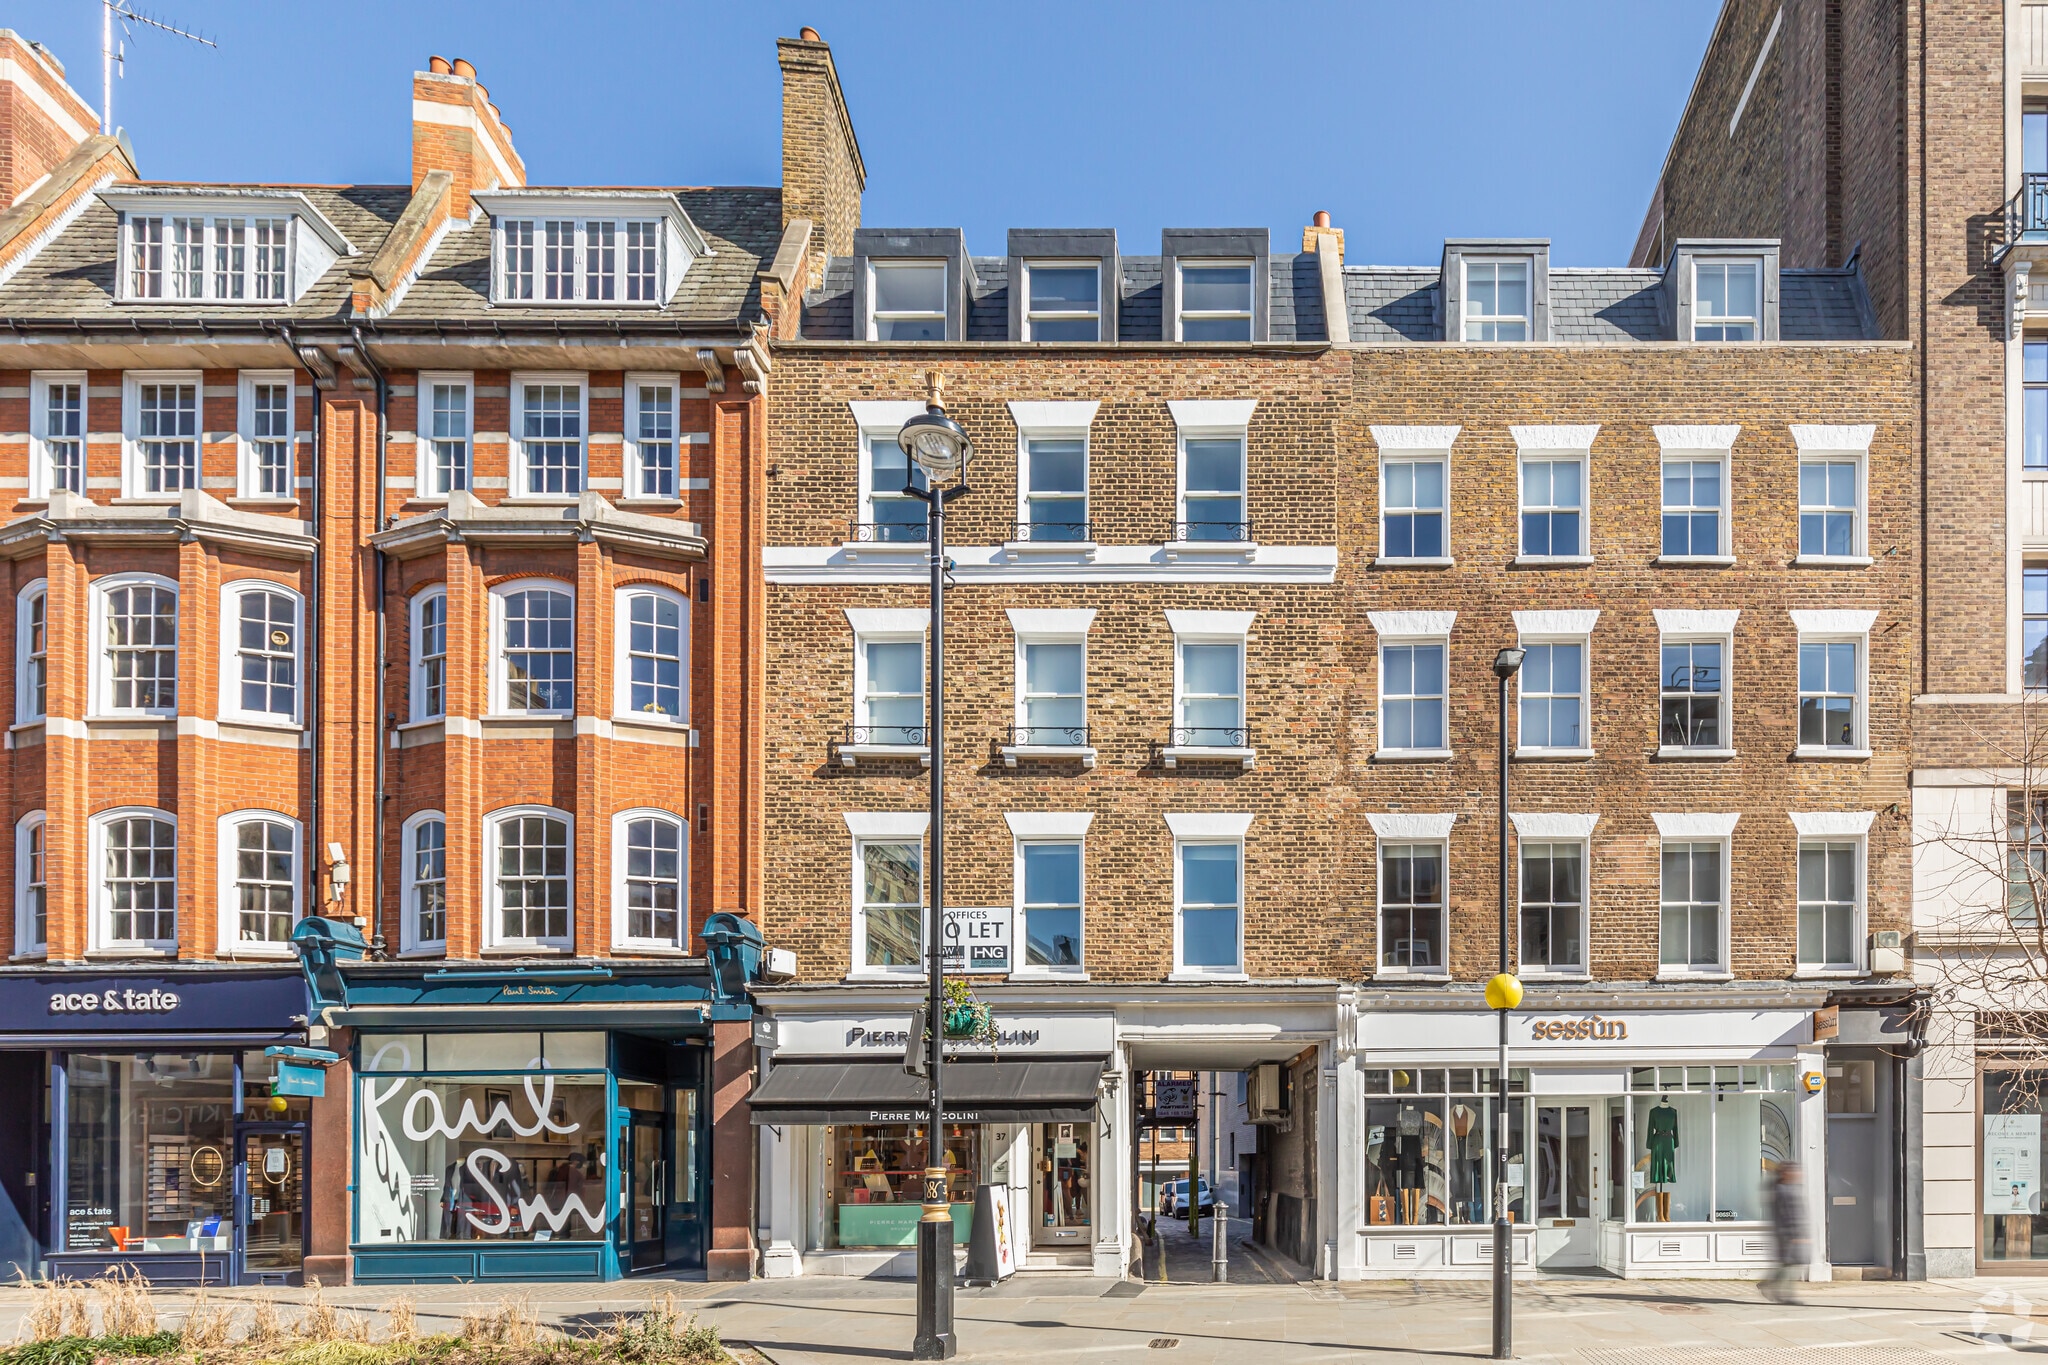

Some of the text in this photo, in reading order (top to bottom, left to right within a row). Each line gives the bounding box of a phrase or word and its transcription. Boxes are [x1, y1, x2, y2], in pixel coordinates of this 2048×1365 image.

[948, 911, 988, 920] OFFICES
[968, 922, 1004, 939] LET
[974, 947, 1004, 959] HNG
[503, 985, 558, 996] Paul Smith
[50, 989, 180, 1011] ace & tate
[1534, 1014, 1630, 1039] sessùn
[851, 1027, 909, 1042] PIERR
[870, 1111, 979, 1121] PIERRE MACOLINI
[996, 1133, 1006, 1141] 37
[1501, 1154, 1507, 1162] 5
